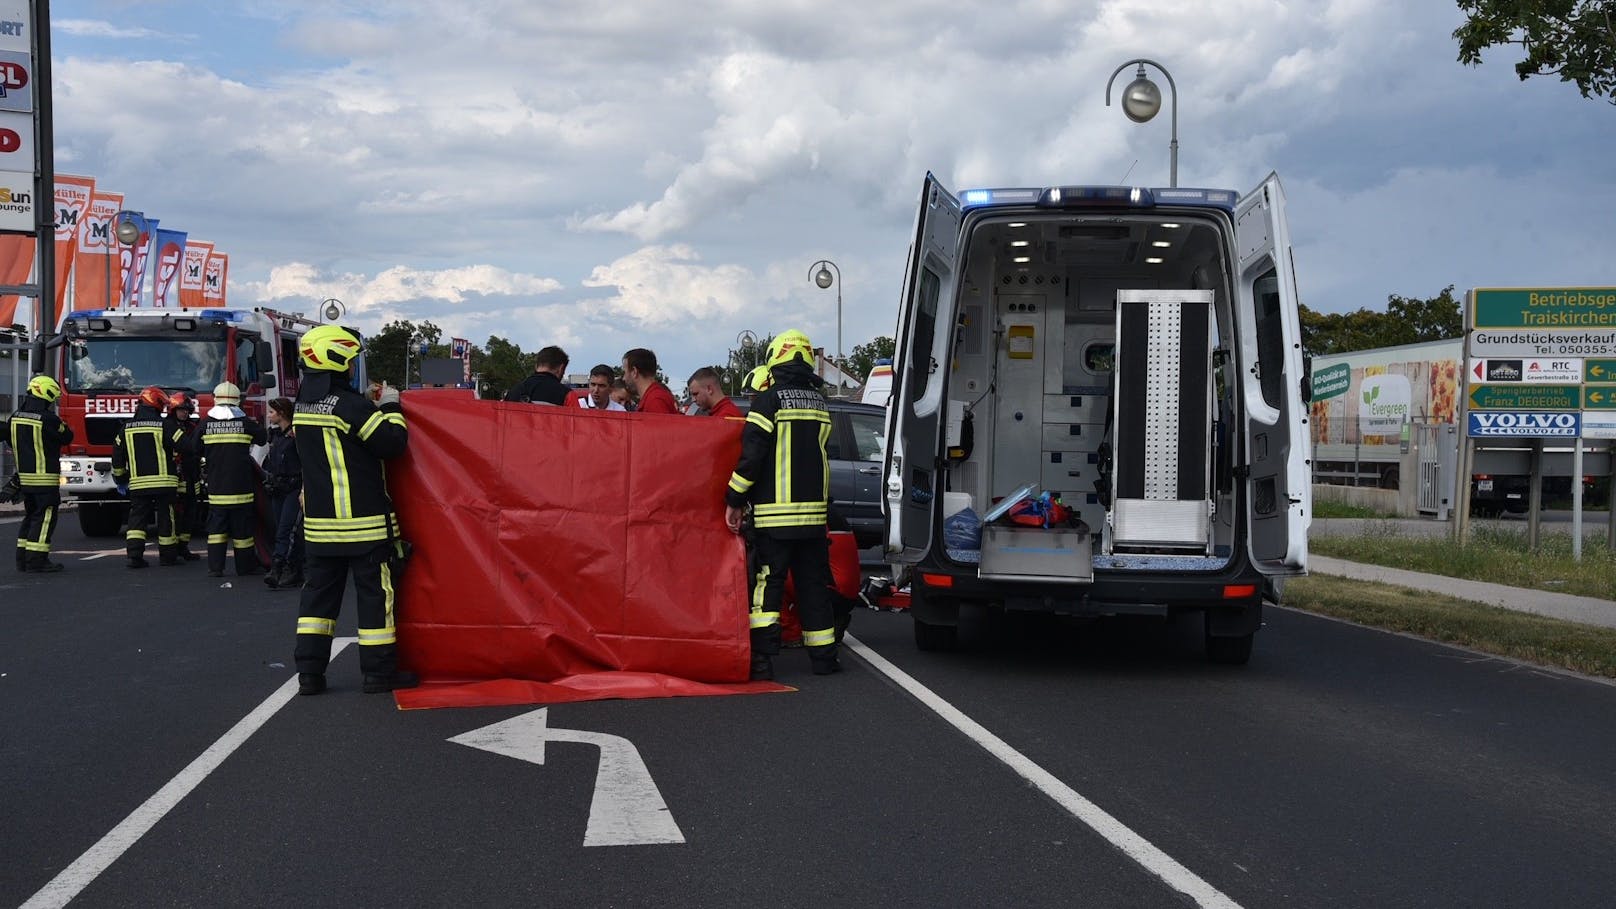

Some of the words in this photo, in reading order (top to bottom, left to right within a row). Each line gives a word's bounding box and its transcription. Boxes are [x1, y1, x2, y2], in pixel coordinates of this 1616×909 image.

[0, 21, 23, 36] RT
[60, 209, 77, 225] M
[92, 223, 107, 237] M
[1521, 311, 1616, 325] Traiskirchen
[1477, 333, 1615, 344] Grundstücksverkauf
[1485, 397, 1514, 406] Franz
[1372, 404, 1407, 417] Evergreen
[1473, 413, 1575, 427] VOLVO
